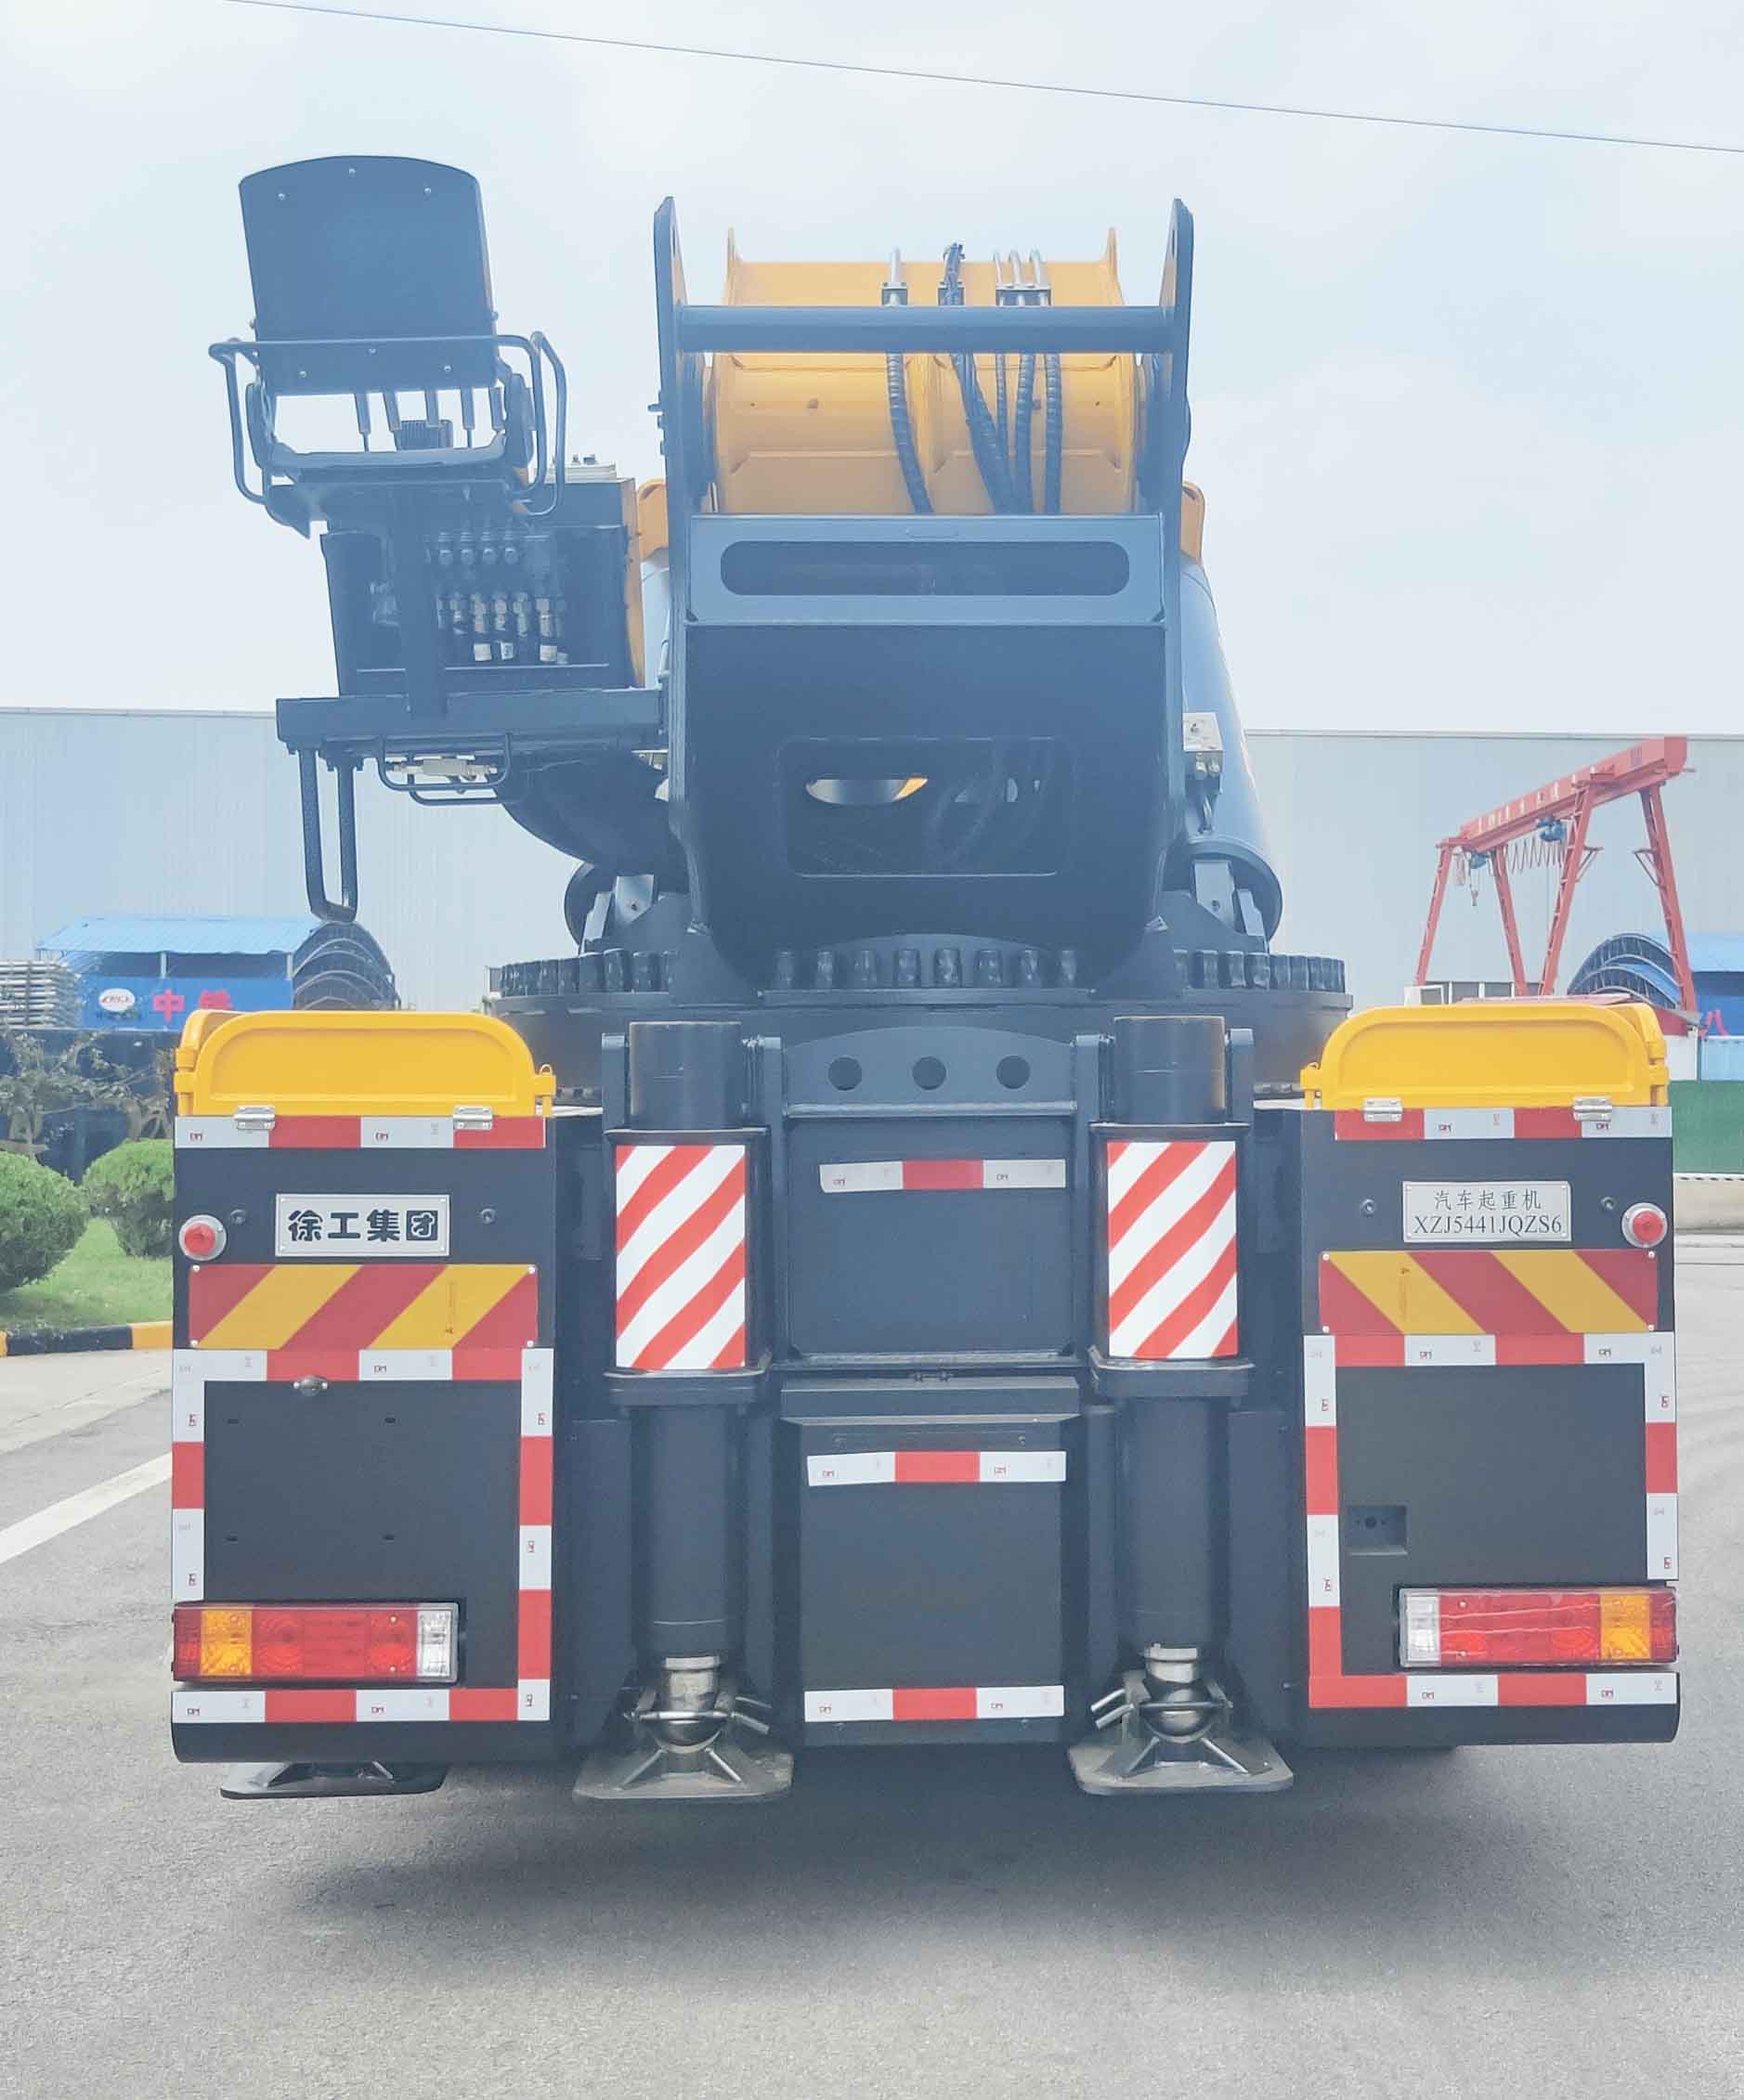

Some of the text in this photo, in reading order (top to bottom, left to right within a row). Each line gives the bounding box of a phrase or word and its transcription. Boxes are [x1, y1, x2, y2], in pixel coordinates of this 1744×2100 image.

[1434, 1188, 1542, 1211] 汽车起重机
[288, 1209, 438, 1242] 徐工集团
[1413, 1214, 1562, 1238] XZJ5441JQZS6
